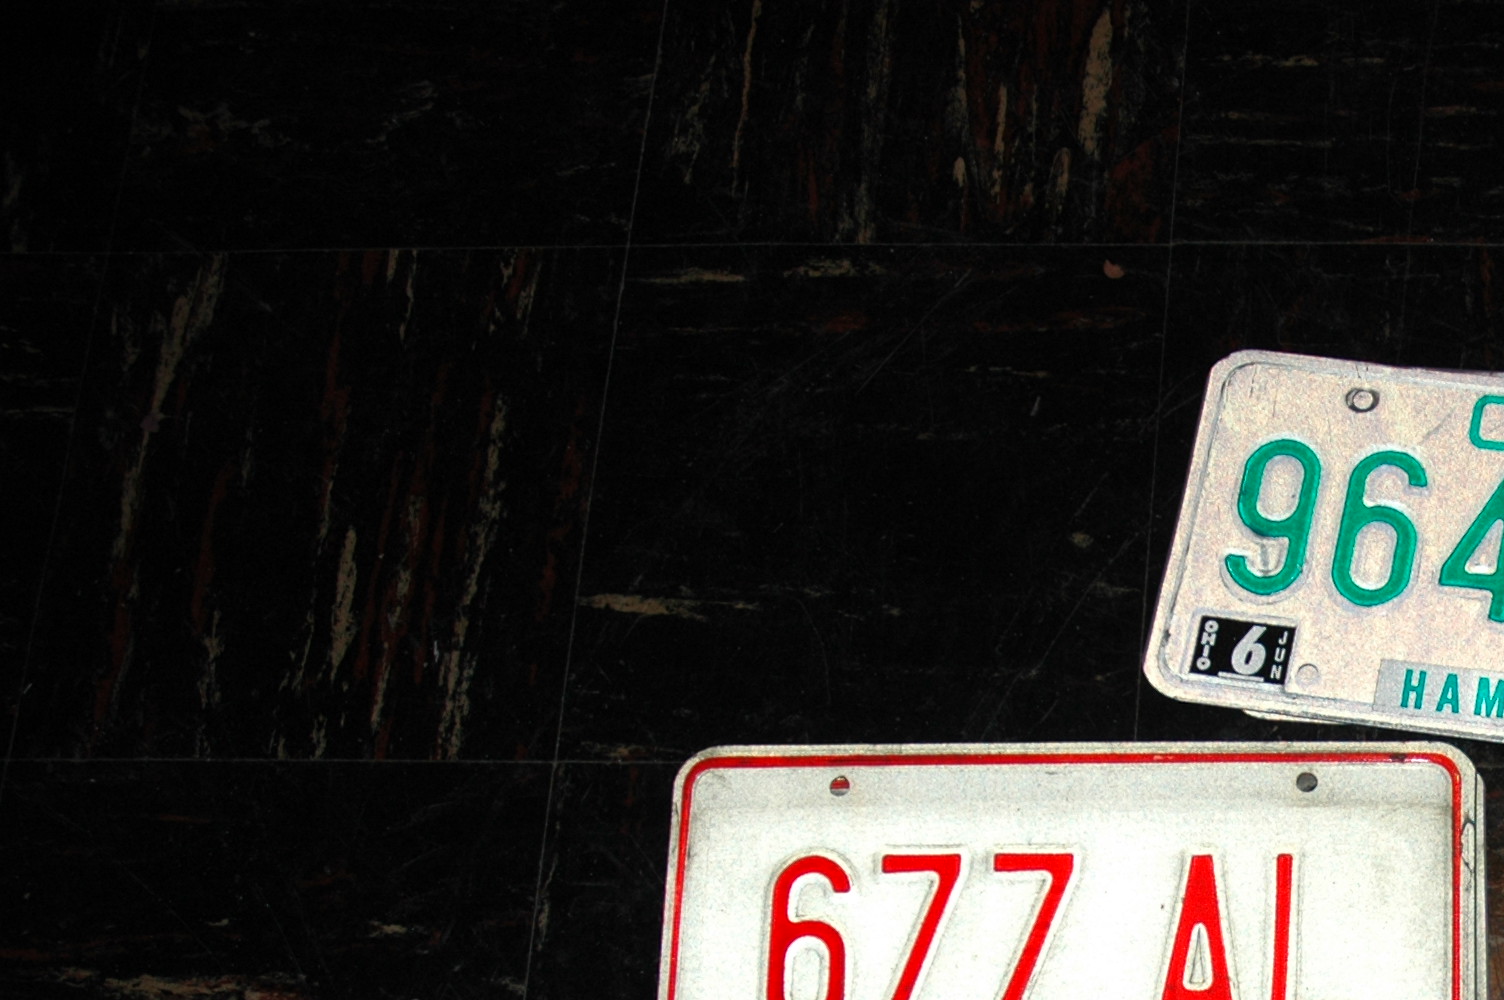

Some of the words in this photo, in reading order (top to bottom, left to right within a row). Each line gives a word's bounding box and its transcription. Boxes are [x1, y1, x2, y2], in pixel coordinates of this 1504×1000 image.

[1196, 619, 1220, 671] OHIO
[1230, 624, 1267, 676] 6
[1270, 630, 1289, 680] JUN
